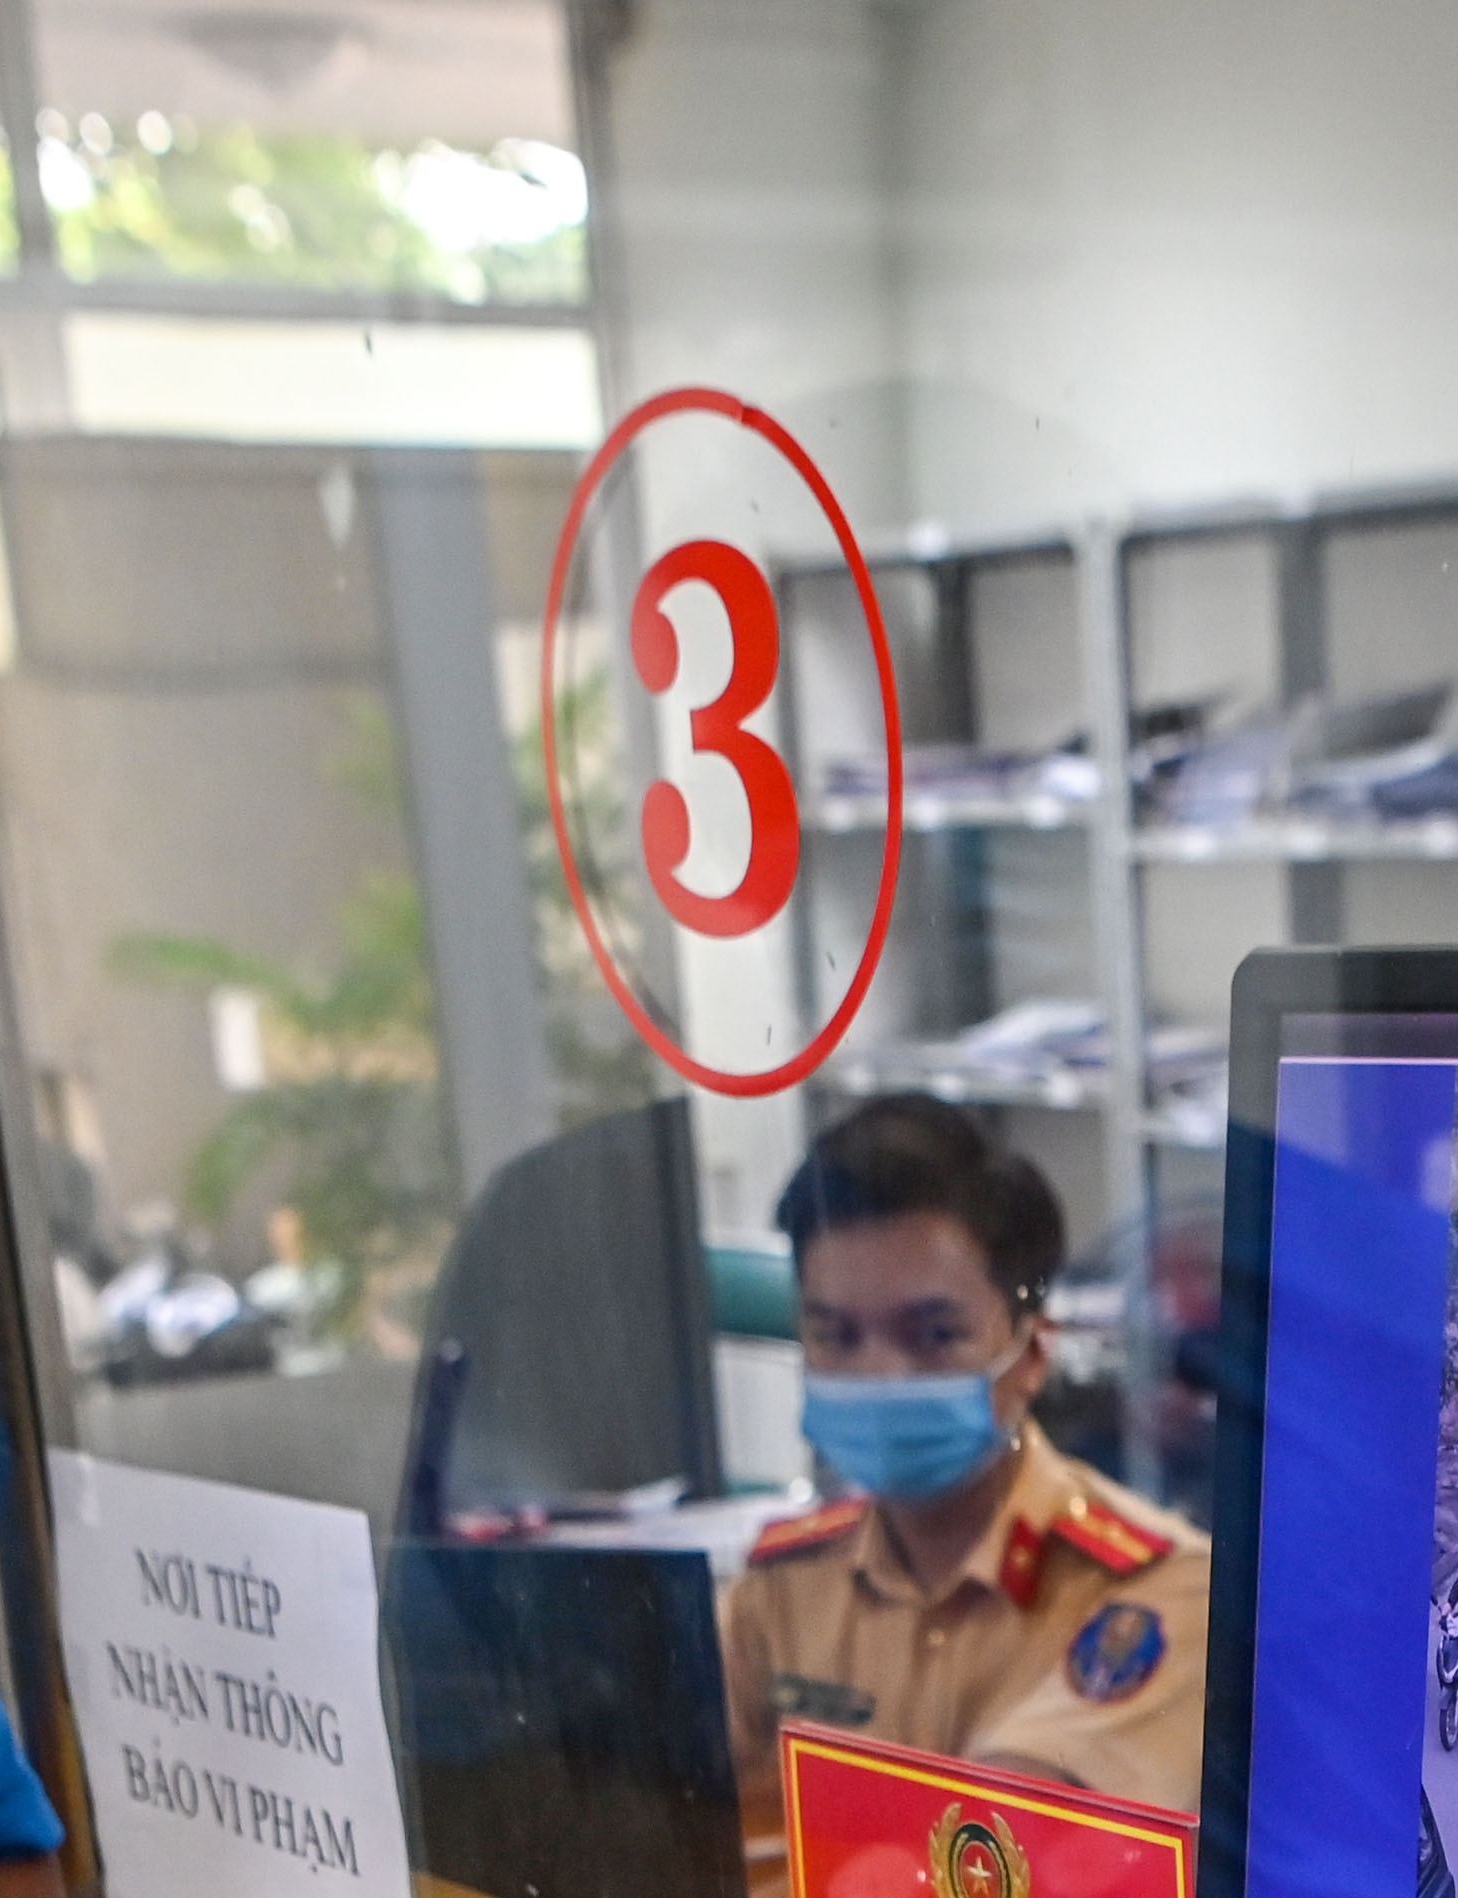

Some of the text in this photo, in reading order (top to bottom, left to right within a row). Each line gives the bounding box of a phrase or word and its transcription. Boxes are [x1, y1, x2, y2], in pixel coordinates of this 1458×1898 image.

[630, 538, 800, 938] 3
[205, 1555, 282, 1638] TIẾP
[106, 1640, 344, 1766] NHẬN THÔNG
[202, 1768, 243, 1837] VI
[247, 1783, 360, 1878] PHẠM
